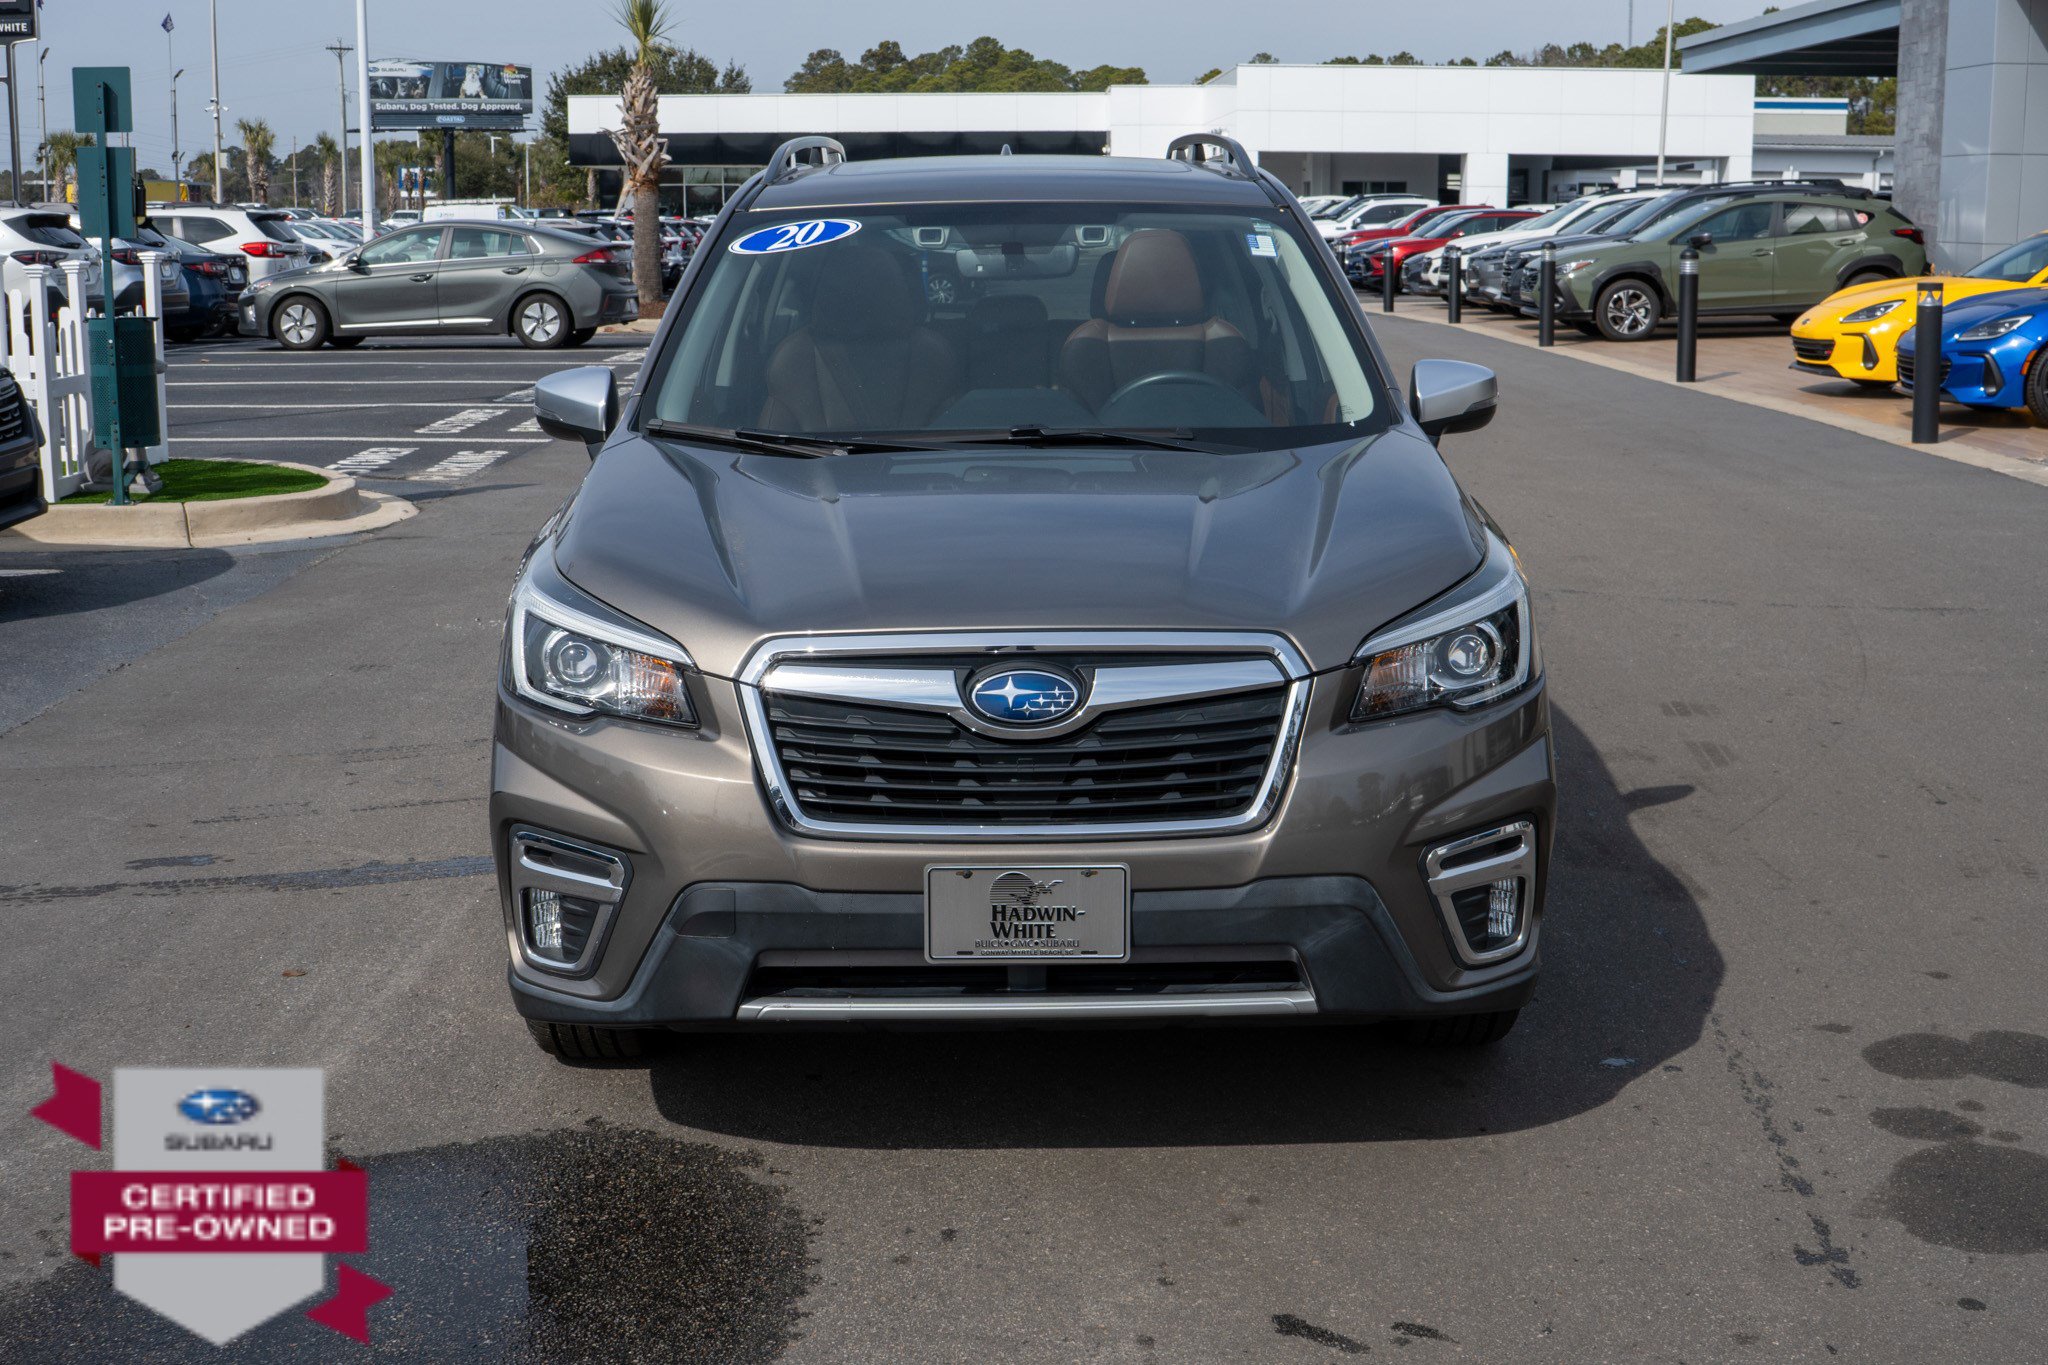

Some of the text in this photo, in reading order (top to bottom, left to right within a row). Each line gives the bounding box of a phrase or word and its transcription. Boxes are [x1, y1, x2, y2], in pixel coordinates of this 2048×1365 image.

[375, 102, 523, 111] Subaru, Dog Tested. Dog Approved.
[766, 221, 825, 251] 20
[991, 904, 1086, 921] HADWIN-
[990, 921, 1056, 939] WHITE
[974, 939, 1080, 948] BUICK GMC SUBARU
